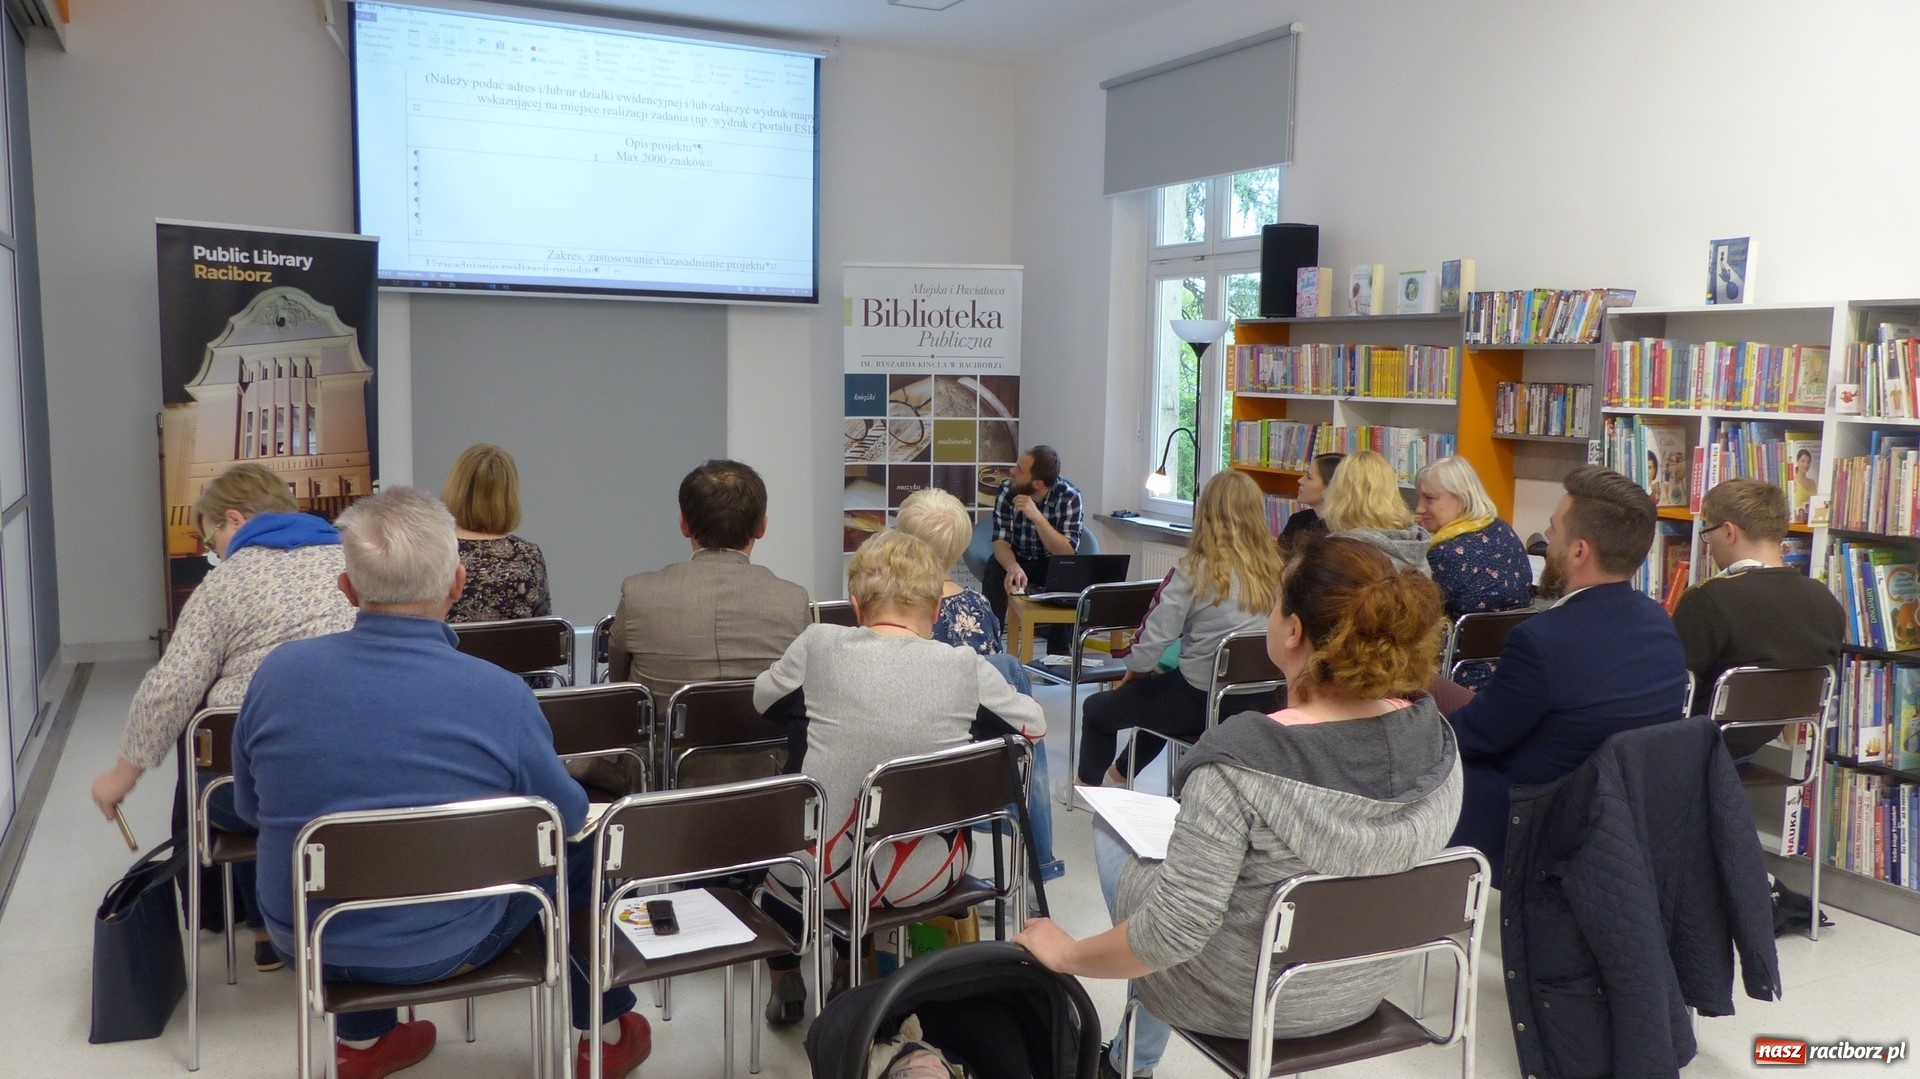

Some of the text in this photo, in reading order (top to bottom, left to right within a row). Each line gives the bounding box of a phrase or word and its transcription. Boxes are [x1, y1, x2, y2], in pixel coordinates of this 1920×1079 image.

[426, 72, 468, 89] (Należy
[472, 76, 504, 90] podać
[508, 81, 536, 93] adres
[540, 83, 562, 96] i/lub
[566, 89, 576, 97] nr
[580, 87, 614, 101] działki
[618, 92, 682, 110] ewidencyjnej
[686, 98, 707, 110] i/lub
[711, 101, 750, 116] załączyć
[754, 106, 788, 120] wydruk
[478, 94, 542, 111] wskazującej
[545, 102, 557, 110] na
[561, 103, 599, 115] miejsce
[602, 106, 649, 120] realizacji
[652, 111, 688, 123] zadania
[691, 115, 709, 127] (np.
[714, 117, 748, 130] wydruk
[759, 122, 792, 133] portalu
[625, 137, 648, 150] Opis
[670, 156, 706, 167] znaków
[193, 245, 313, 272] Public Library
[588, 254, 653, 265] zastosowanie
[663, 257, 724, 268] uzasadnienie
[194, 264, 272, 283] Raciborz
[911, 283, 1005, 297] Miejska i Powiatowa
[861, 298, 1005, 329] Biblioteka
[917, 330, 993, 350] Publiczna
[1866, 587, 1877, 624] DINOZAURY
[1787, 810, 1798, 853] NAUKA
